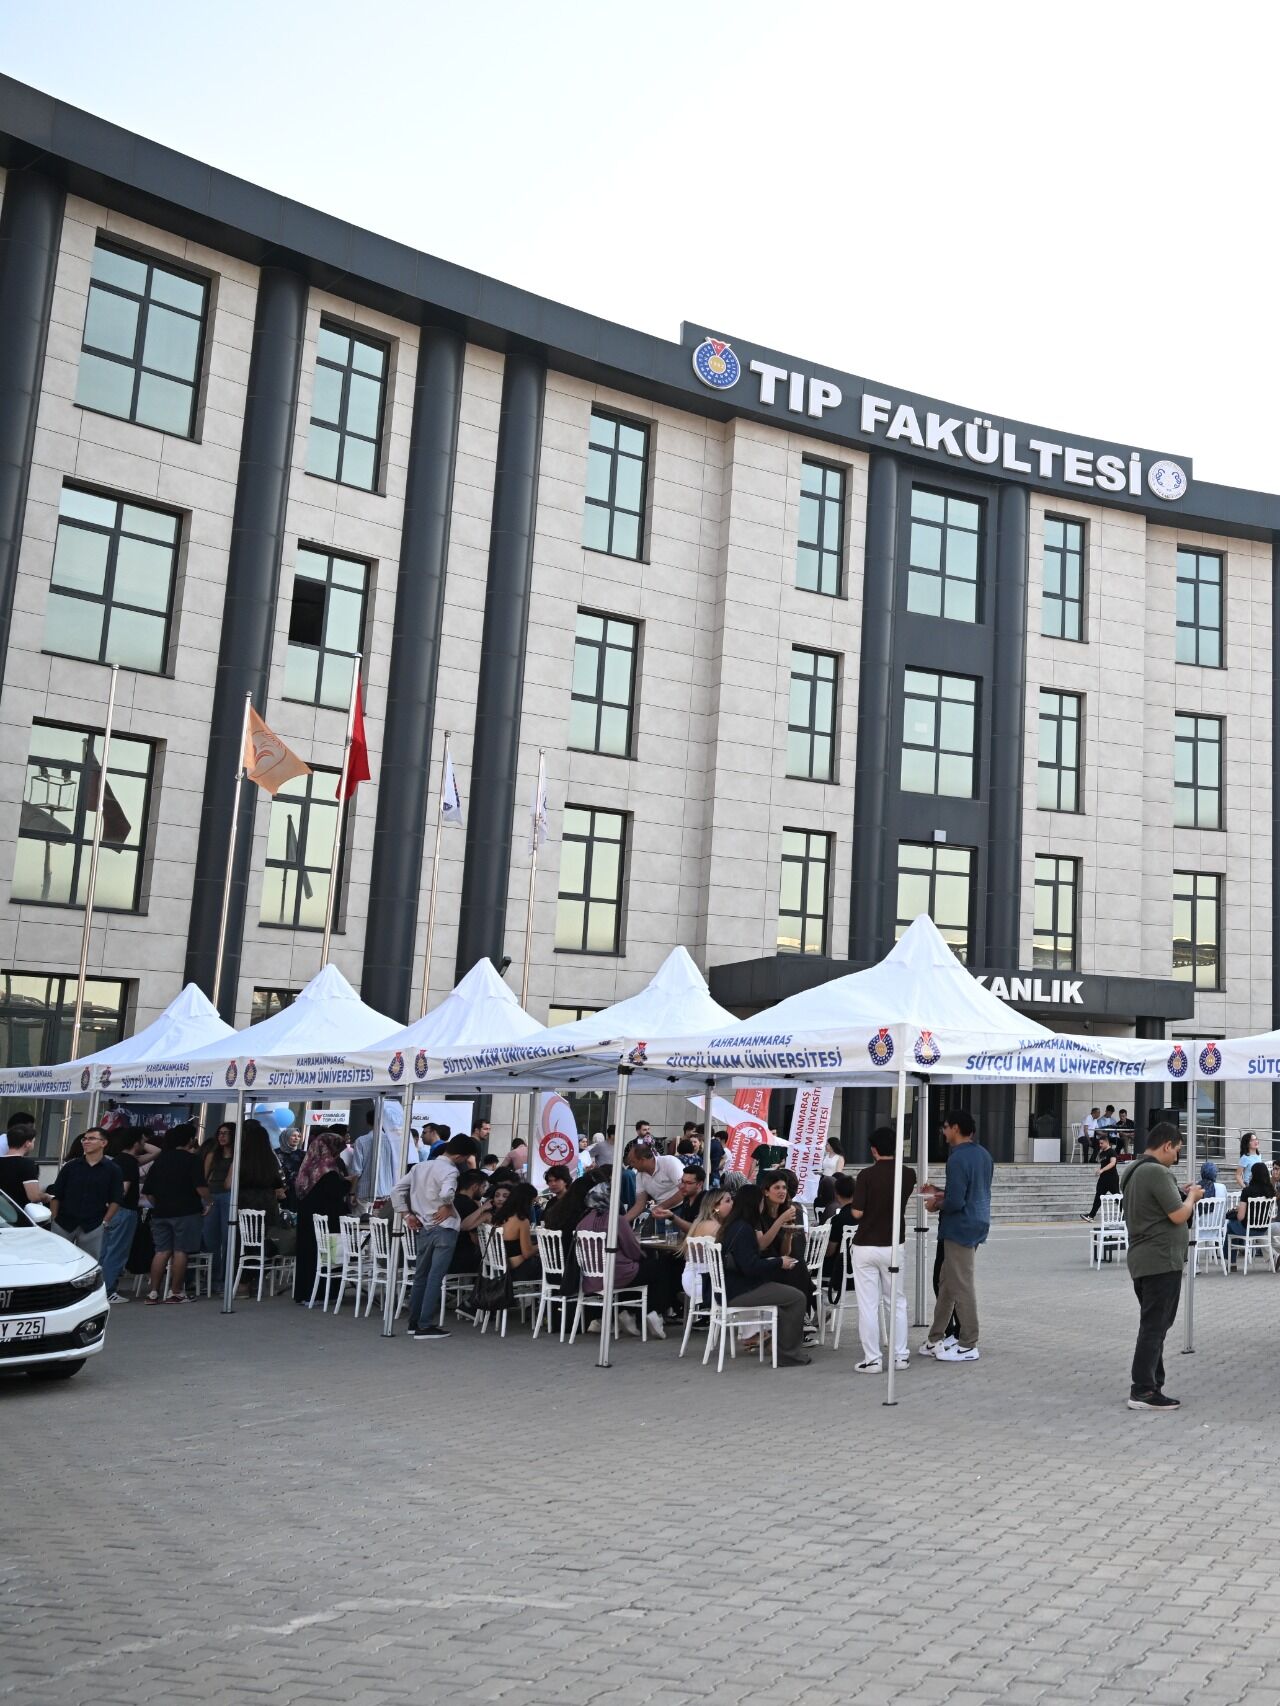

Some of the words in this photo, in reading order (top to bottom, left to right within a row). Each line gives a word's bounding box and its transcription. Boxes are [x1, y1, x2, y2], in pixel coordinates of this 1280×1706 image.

[749, 359, 842, 418] TIP
[860, 393, 1142, 496] FAKÜLTESİ
[975, 975, 1084, 1004] ANLIK
[707, 1034, 793, 1049] KAHRAMANMARAŞ
[296, 1056, 346, 1067] KAHRAMANMARAŞ
[707, 1050, 743, 1069] İMAM
[744, 1046, 843, 1070] ÜNİVERSİTESİ
[965, 1052, 1013, 1075] SÜTÇÜ
[1016, 1052, 1055, 1073] İMAM
[1059, 1053, 1147, 1077] ÜNİVERSİTESİ
[268, 1069, 294, 1088] SÜTÇÜ
[294, 1068, 316, 1085] İMAM
[317, 1065, 374, 1084] ÜNİVERSİTESİ
[790, 1091, 810, 1172] AHRAMANMARAŞ
[815, 1107, 829, 1151] FAKÜLTESİ
[812, 1153, 821, 1166] TIP
[0, 1290, 14, 1308] AT
[16, 1320, 41, 1336] 225
